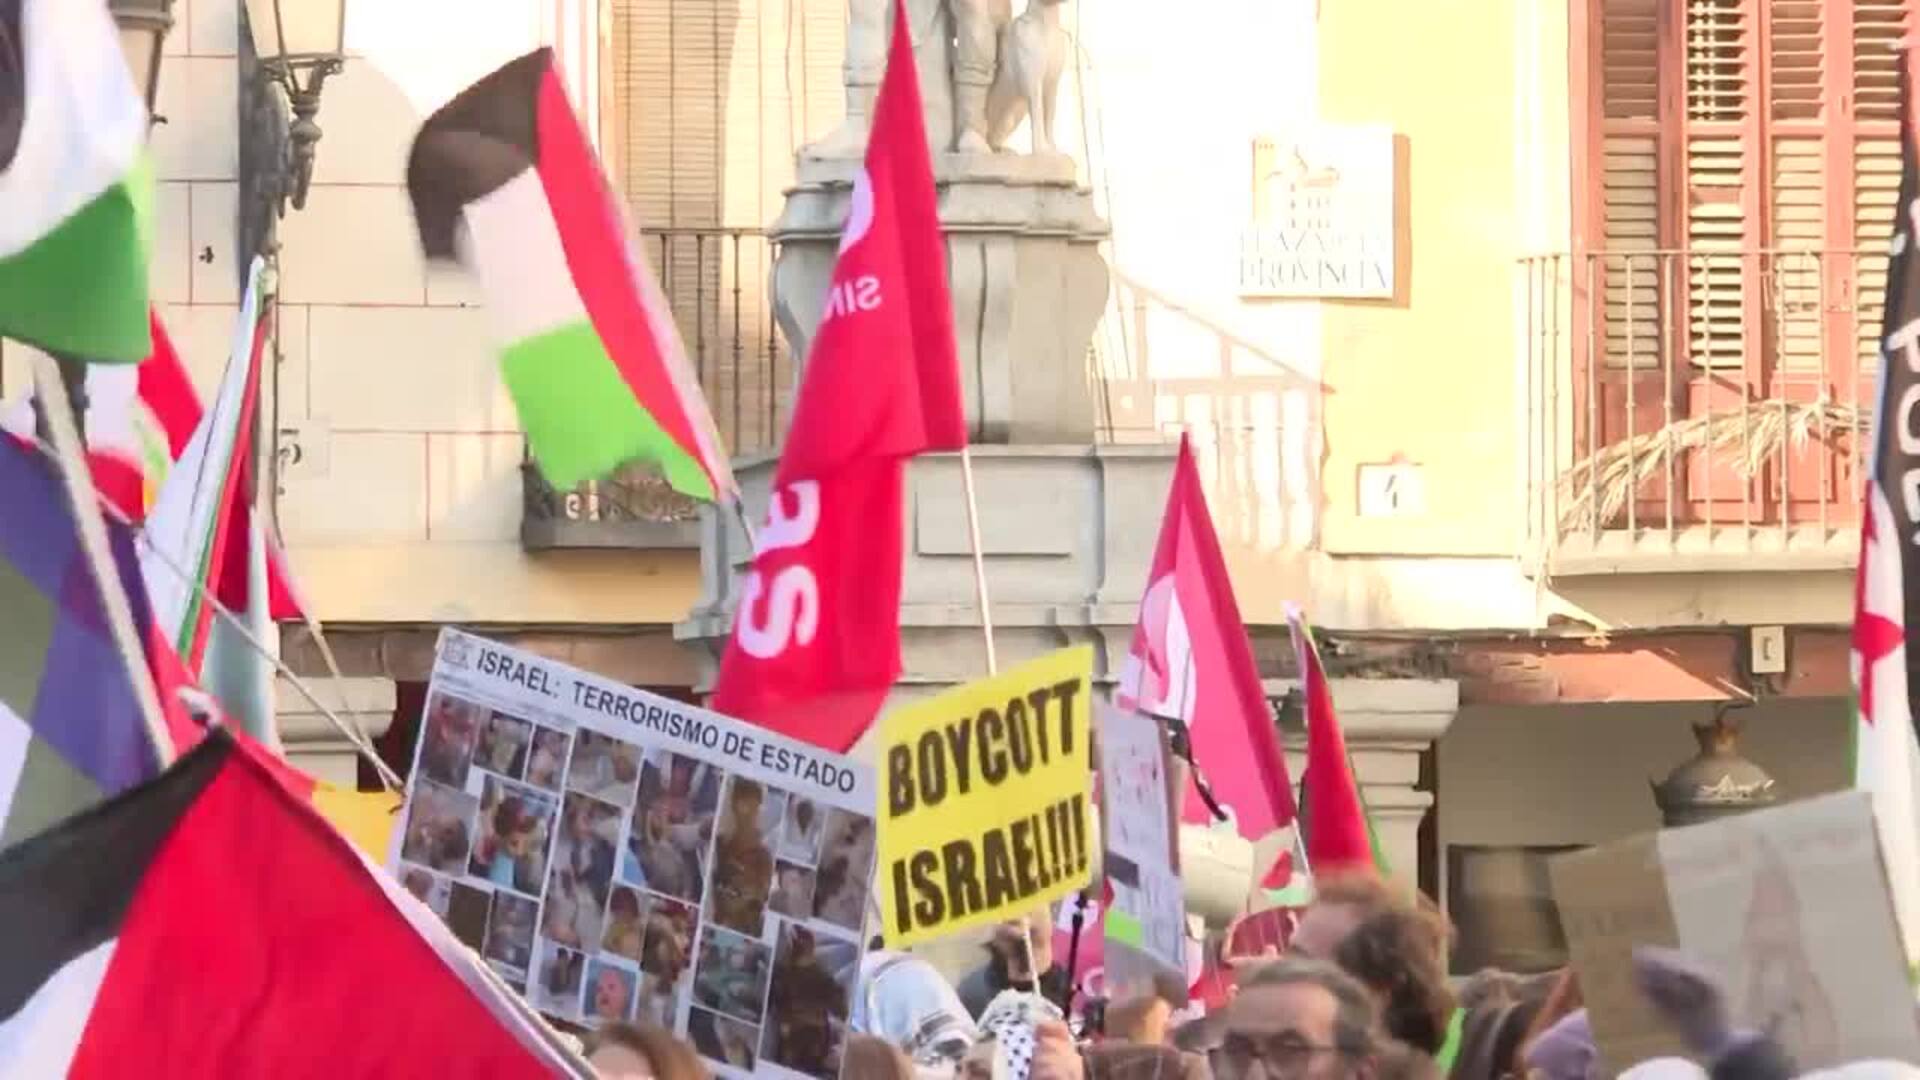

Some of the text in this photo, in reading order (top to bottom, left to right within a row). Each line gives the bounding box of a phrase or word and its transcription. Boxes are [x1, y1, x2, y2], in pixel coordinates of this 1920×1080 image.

[477, 647, 561, 699] ISRAEL:
[572, 680, 719, 748] TERRORISMO
[723, 730, 755, 762] DE
[760, 743, 855, 793] ESTADO
[888, 677, 1082, 818] BOYCOTT
[892, 791, 1087, 935] ISRAEL!!!
